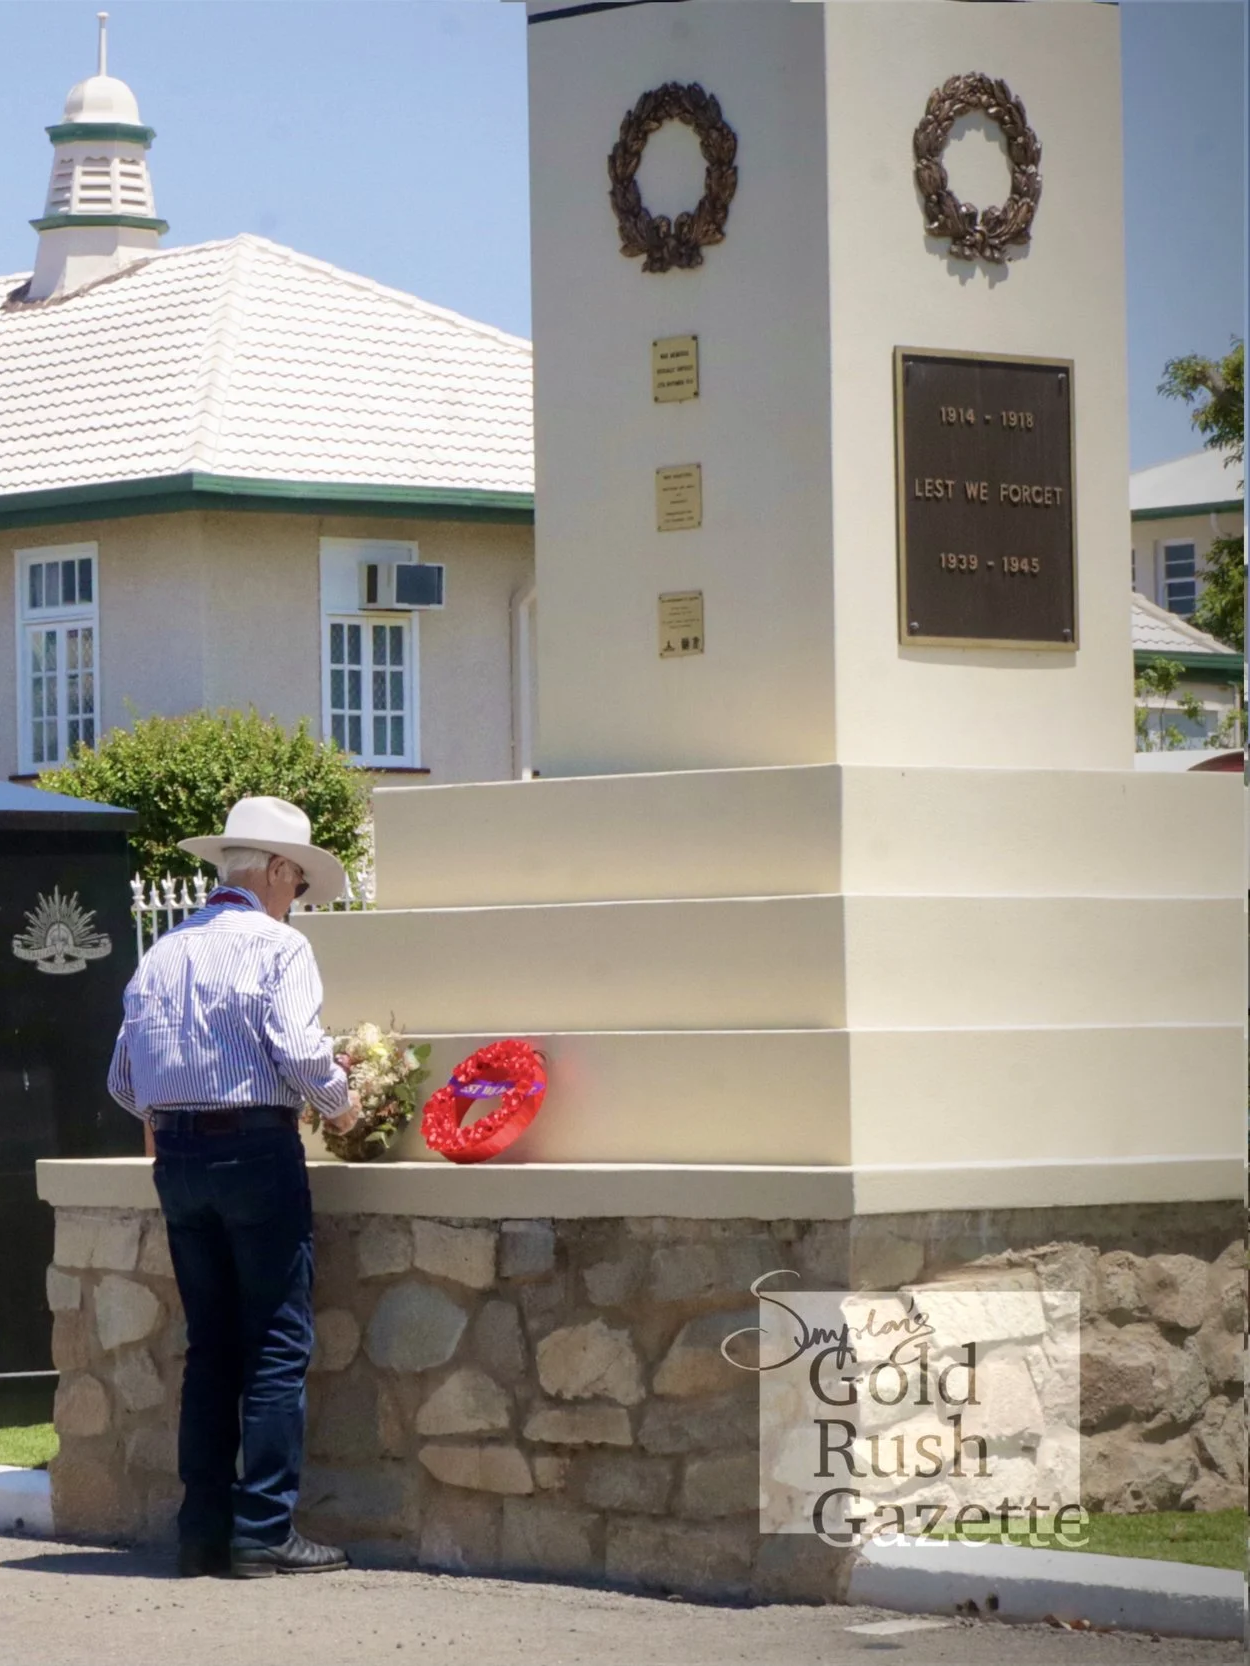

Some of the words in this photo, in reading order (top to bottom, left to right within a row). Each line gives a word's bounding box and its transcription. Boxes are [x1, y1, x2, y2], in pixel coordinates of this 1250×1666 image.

[939, 406, 976, 424] 1914
[1000, 409, 1034, 429] 1918
[914, 477, 954, 499] LEST
[965, 479, 989, 501] WE
[1000, 481, 1063, 505] FORGET
[939, 552, 978, 571] 1939
[1002, 555, 1040, 574] 1945
